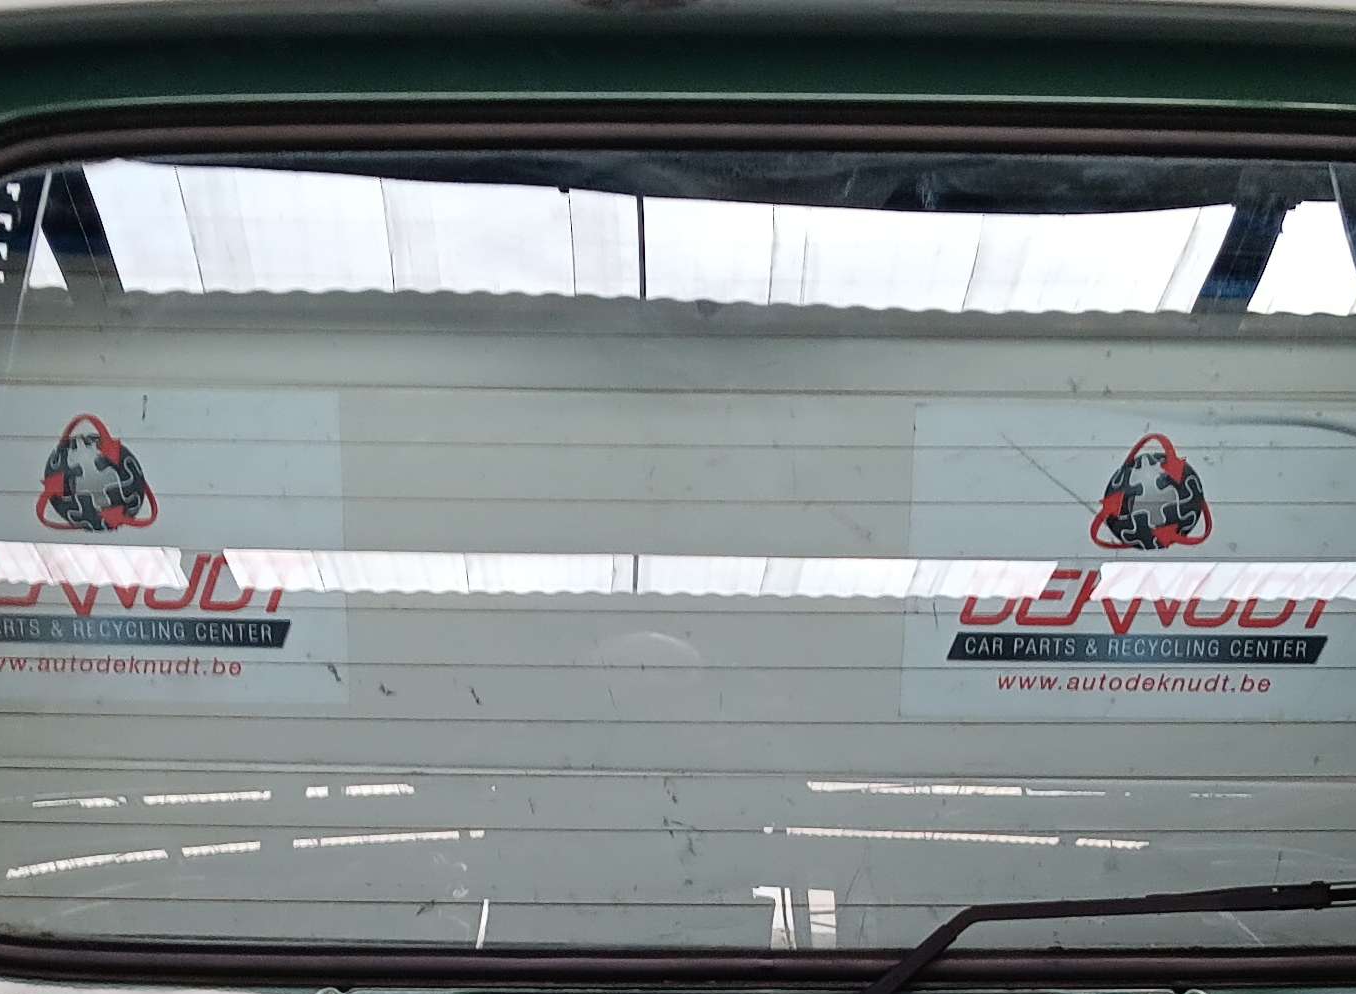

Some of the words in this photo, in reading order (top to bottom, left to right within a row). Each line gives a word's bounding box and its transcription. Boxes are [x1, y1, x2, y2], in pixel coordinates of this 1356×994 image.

[51, 619, 63, 638] &
[73, 618, 185, 641] RECYCLING
[195, 621, 272, 643] CENTER
[964, 636, 1003, 655] CAR
[1013, 637, 1075, 656] PARTS
[1085, 637, 1098, 656] &
[1108, 637, 1220, 658] RECYCLING
[1230, 638, 1307, 659] CENTER
[997, 673, 1272, 693] www.autodeknudt.be
